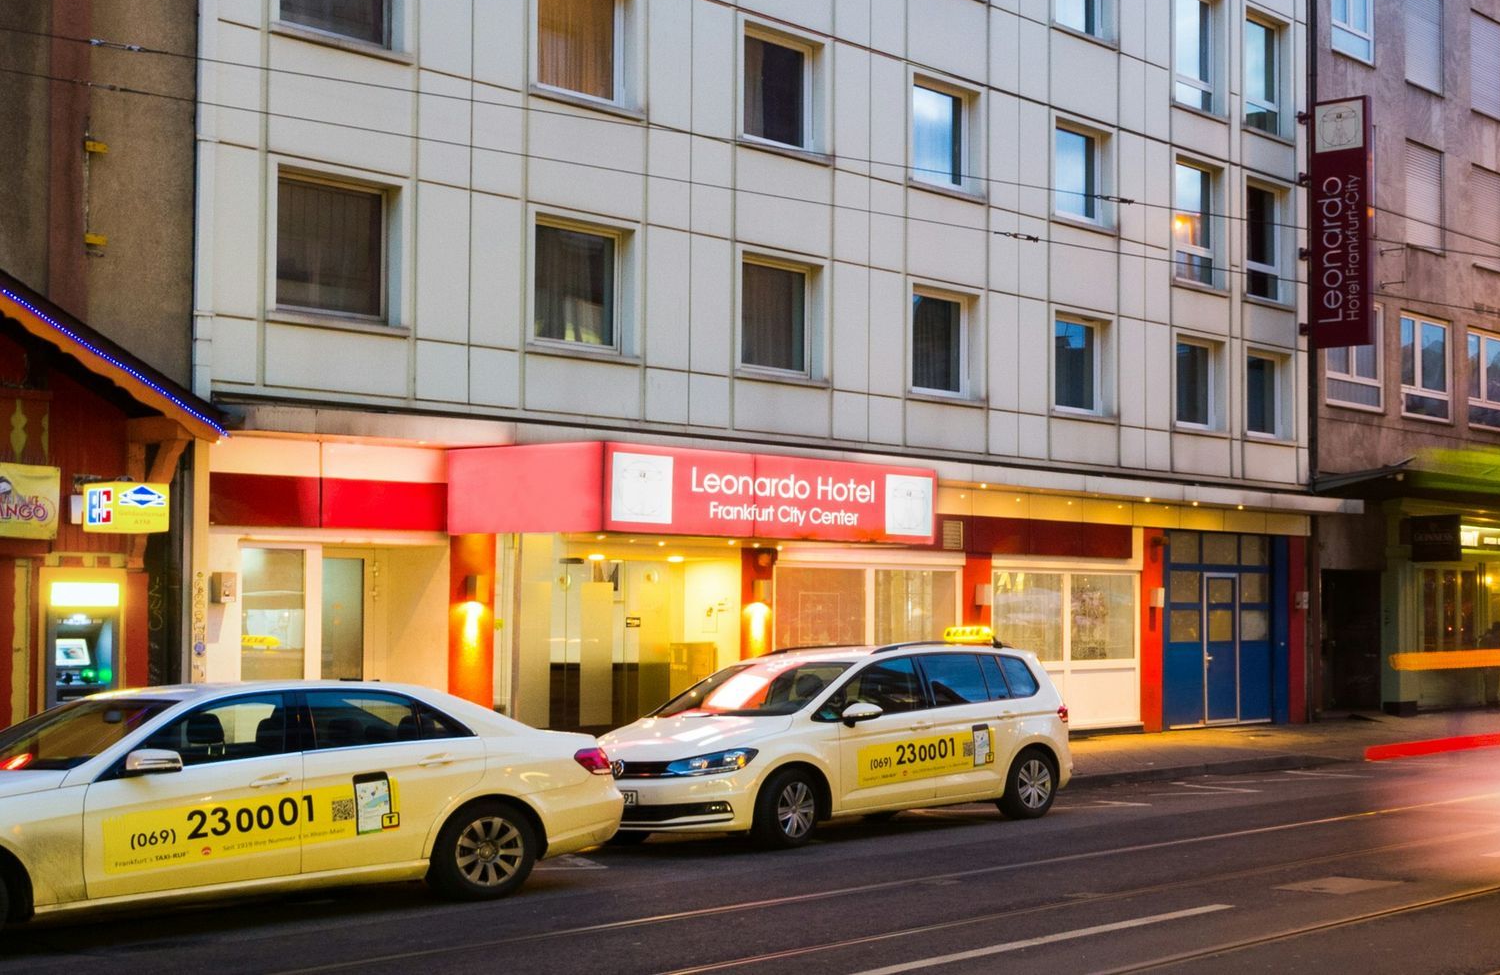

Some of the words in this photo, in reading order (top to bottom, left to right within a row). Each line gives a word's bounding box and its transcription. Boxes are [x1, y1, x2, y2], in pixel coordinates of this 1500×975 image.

[1345, 174, 1361, 275] Frankfurt-City
[1317, 176, 1343, 323] Leonardo
[1346, 277, 1361, 321] Hotel
[691, 466, 810, 500] Leonardo
[817, 476, 875, 503] Hotel
[709, 501, 775, 522] Frankfurt
[777, 506, 806, 527] City
[809, 508, 859, 526] Center
[870, 757, 892, 770] (069)
[131, 829, 176, 850] (069)
